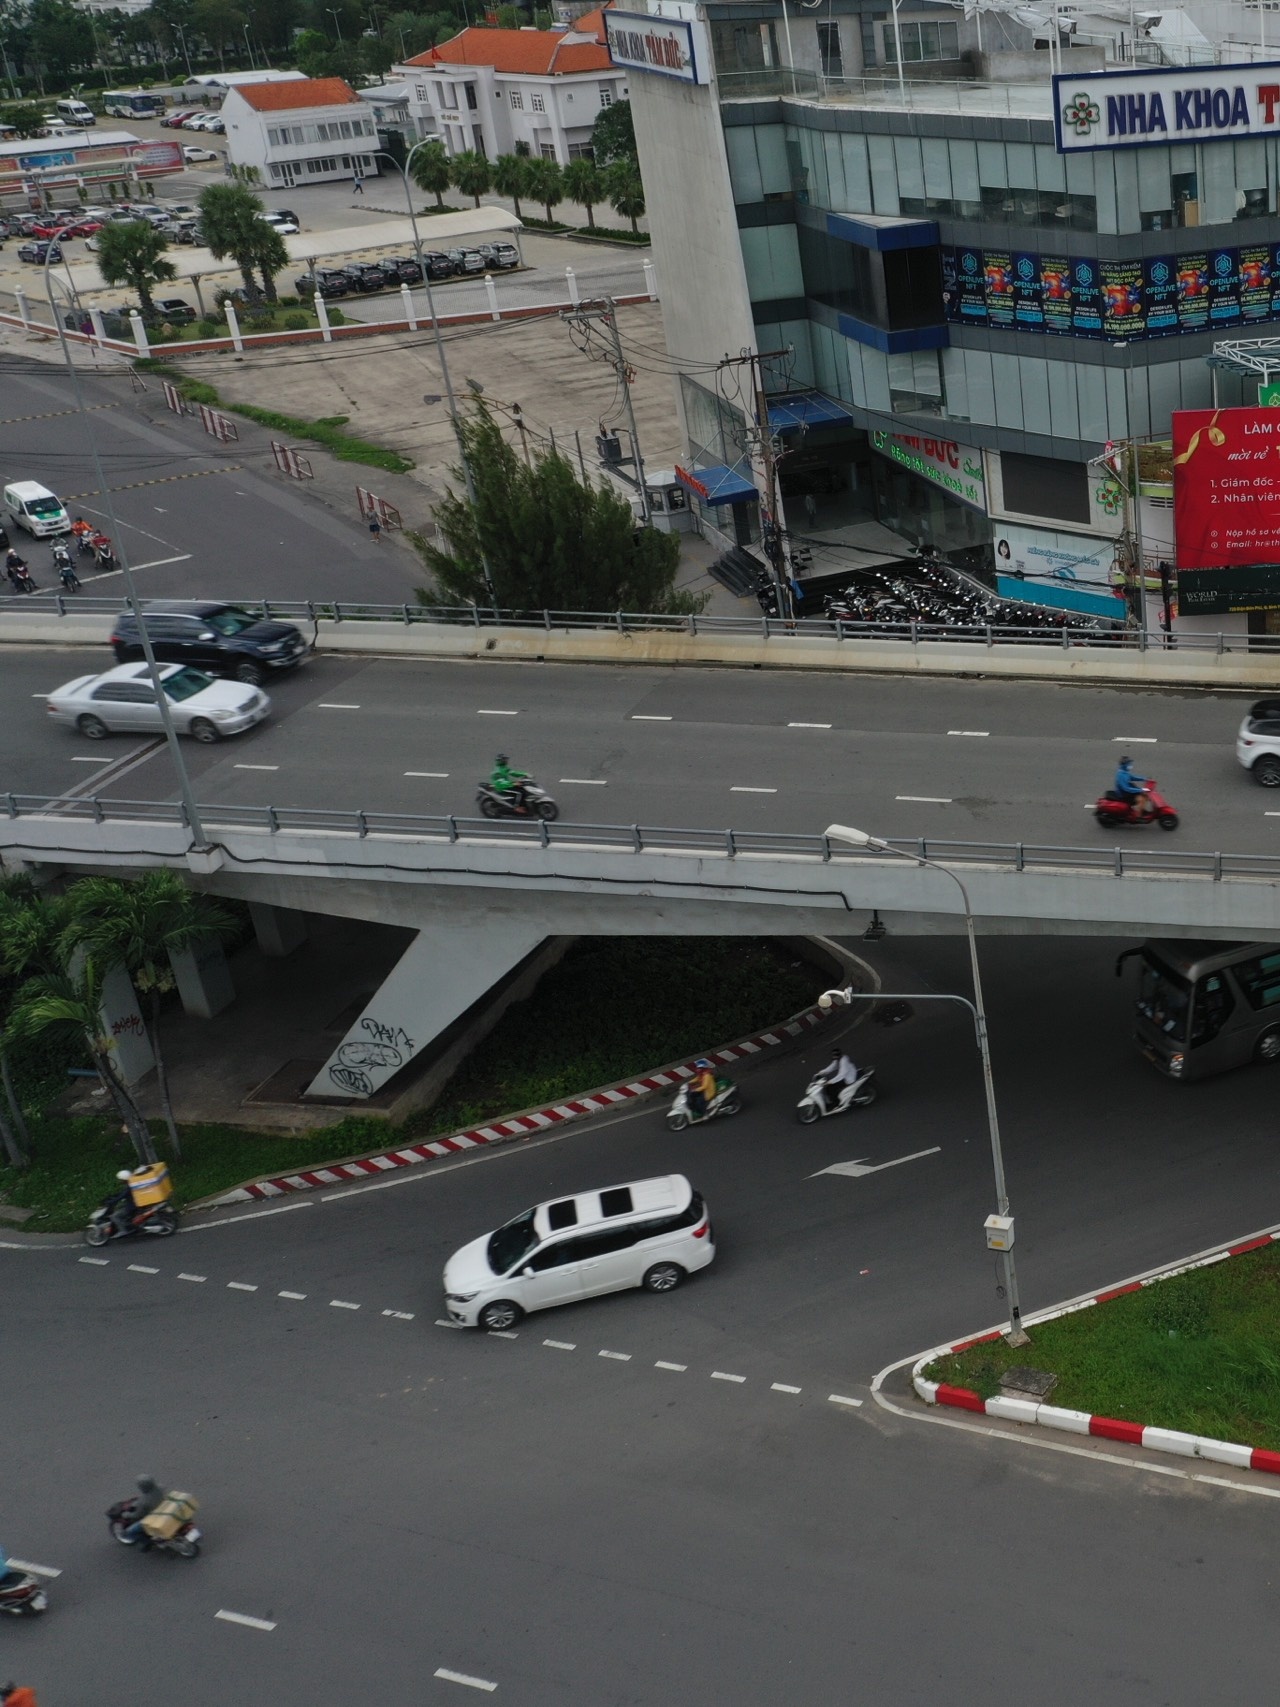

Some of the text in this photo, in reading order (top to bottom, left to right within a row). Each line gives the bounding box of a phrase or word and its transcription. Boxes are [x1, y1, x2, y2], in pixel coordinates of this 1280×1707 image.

[1106, 93, 1167, 136] NHA
[1173, 86, 1249, 131] KHOA
[1013, 281, 1041, 289] OPENLIVE
[1210, 276, 1238, 286] OPENLIVE
[1072, 287, 1099, 295] OPENLIVE
[1146, 285, 1175, 294] OPENLIVE
[1218, 285, 1230, 293] NFT
[1244, 421, 1272, 435] LÀM
[1227, 448, 1252, 461] mời
[1253, 445, 1270, 460] về
[1210, 479, 1218, 488] 1.
[1221, 478, 1250, 488] Giám
[1253, 476, 1273, 487] đốc
[1211, 494, 1220, 504] 2.
[1224, 493, 1254, 503] Nhân
[1226, 529, 1243, 538] Nộp
[1246, 527, 1257, 536] hồ
[1259, 528, 1269, 536] sơ
[1226, 540, 1253, 549] Email:
[1186, 590, 1218, 599] WORLD
